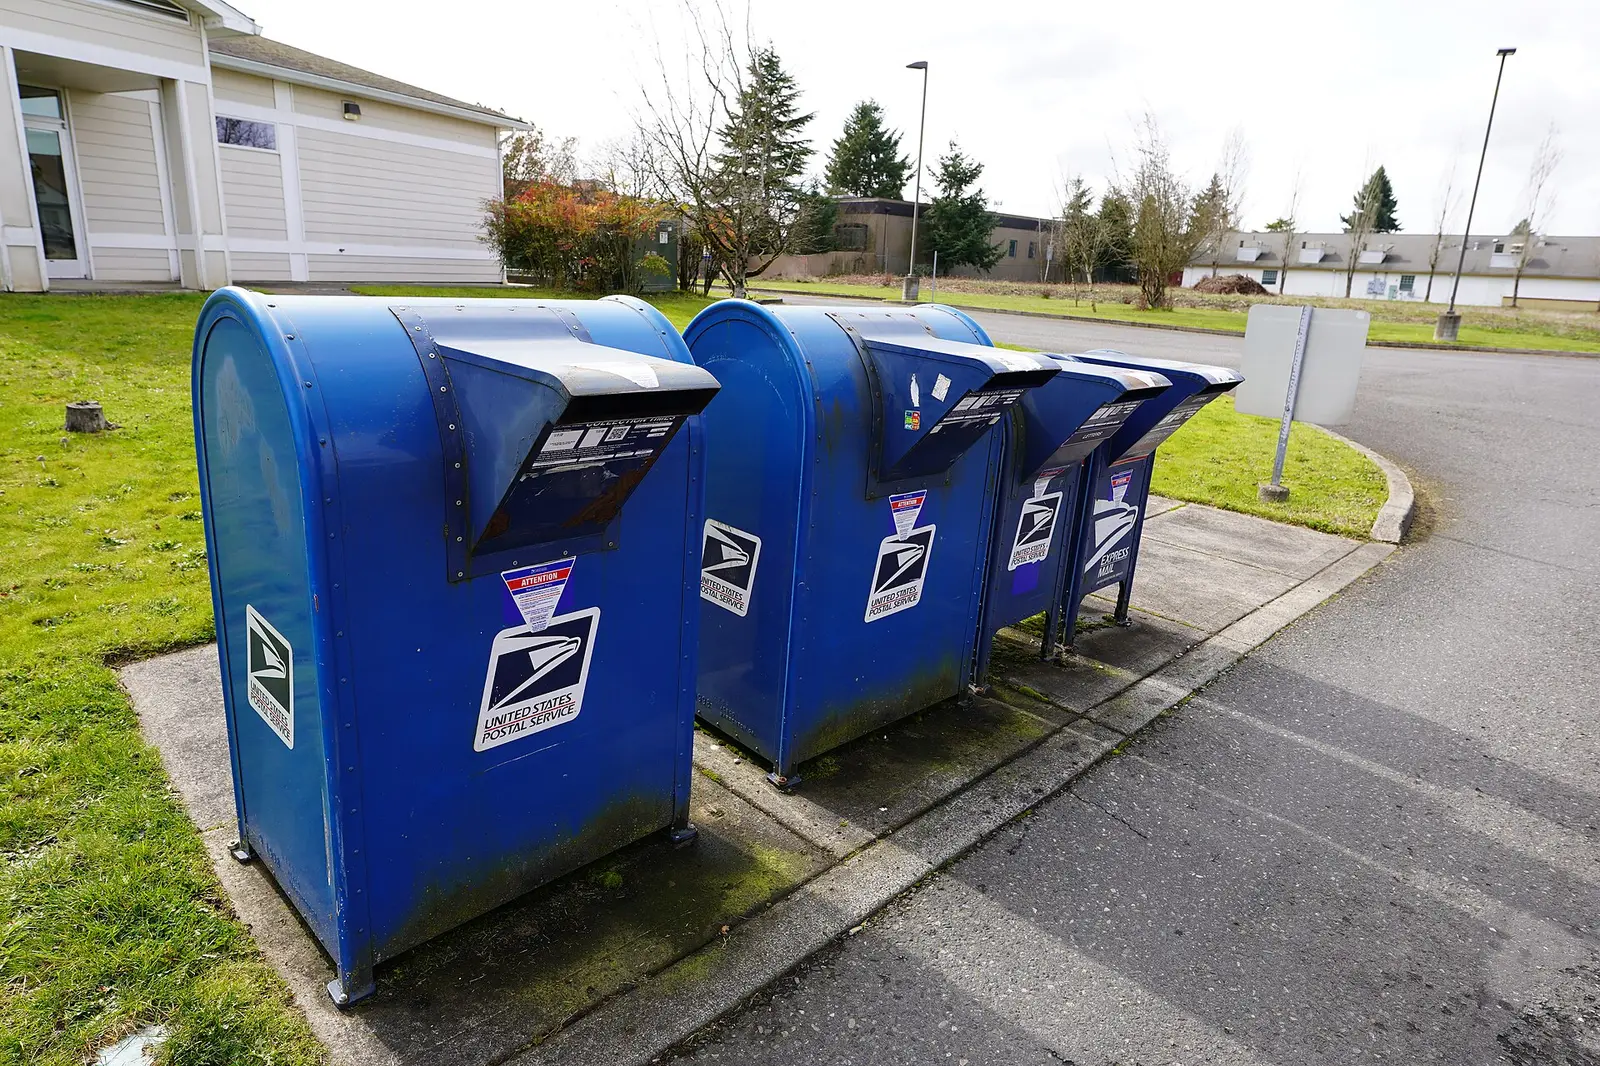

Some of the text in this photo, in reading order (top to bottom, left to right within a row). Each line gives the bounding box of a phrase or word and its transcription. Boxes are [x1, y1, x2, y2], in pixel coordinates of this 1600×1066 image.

[1101, 546, 1130, 566] EXPRESS
[521, 572, 558, 587] ATTENTION
[1097, 563, 1114, 578] MAIL
[719, 594, 745, 612] SERVICE
[721, 586, 743, 601] STATES
[871, 585, 918, 607] UNITED STATES
[868, 593, 918, 617] POSTAL SERVICE
[250, 680, 289, 727] UNITED STATES
[484, 692, 573, 729] UNITED STATES
[250, 691, 291, 742] POSTAL SERVICE
[481, 704, 575, 744] POSTAL SERVICE
